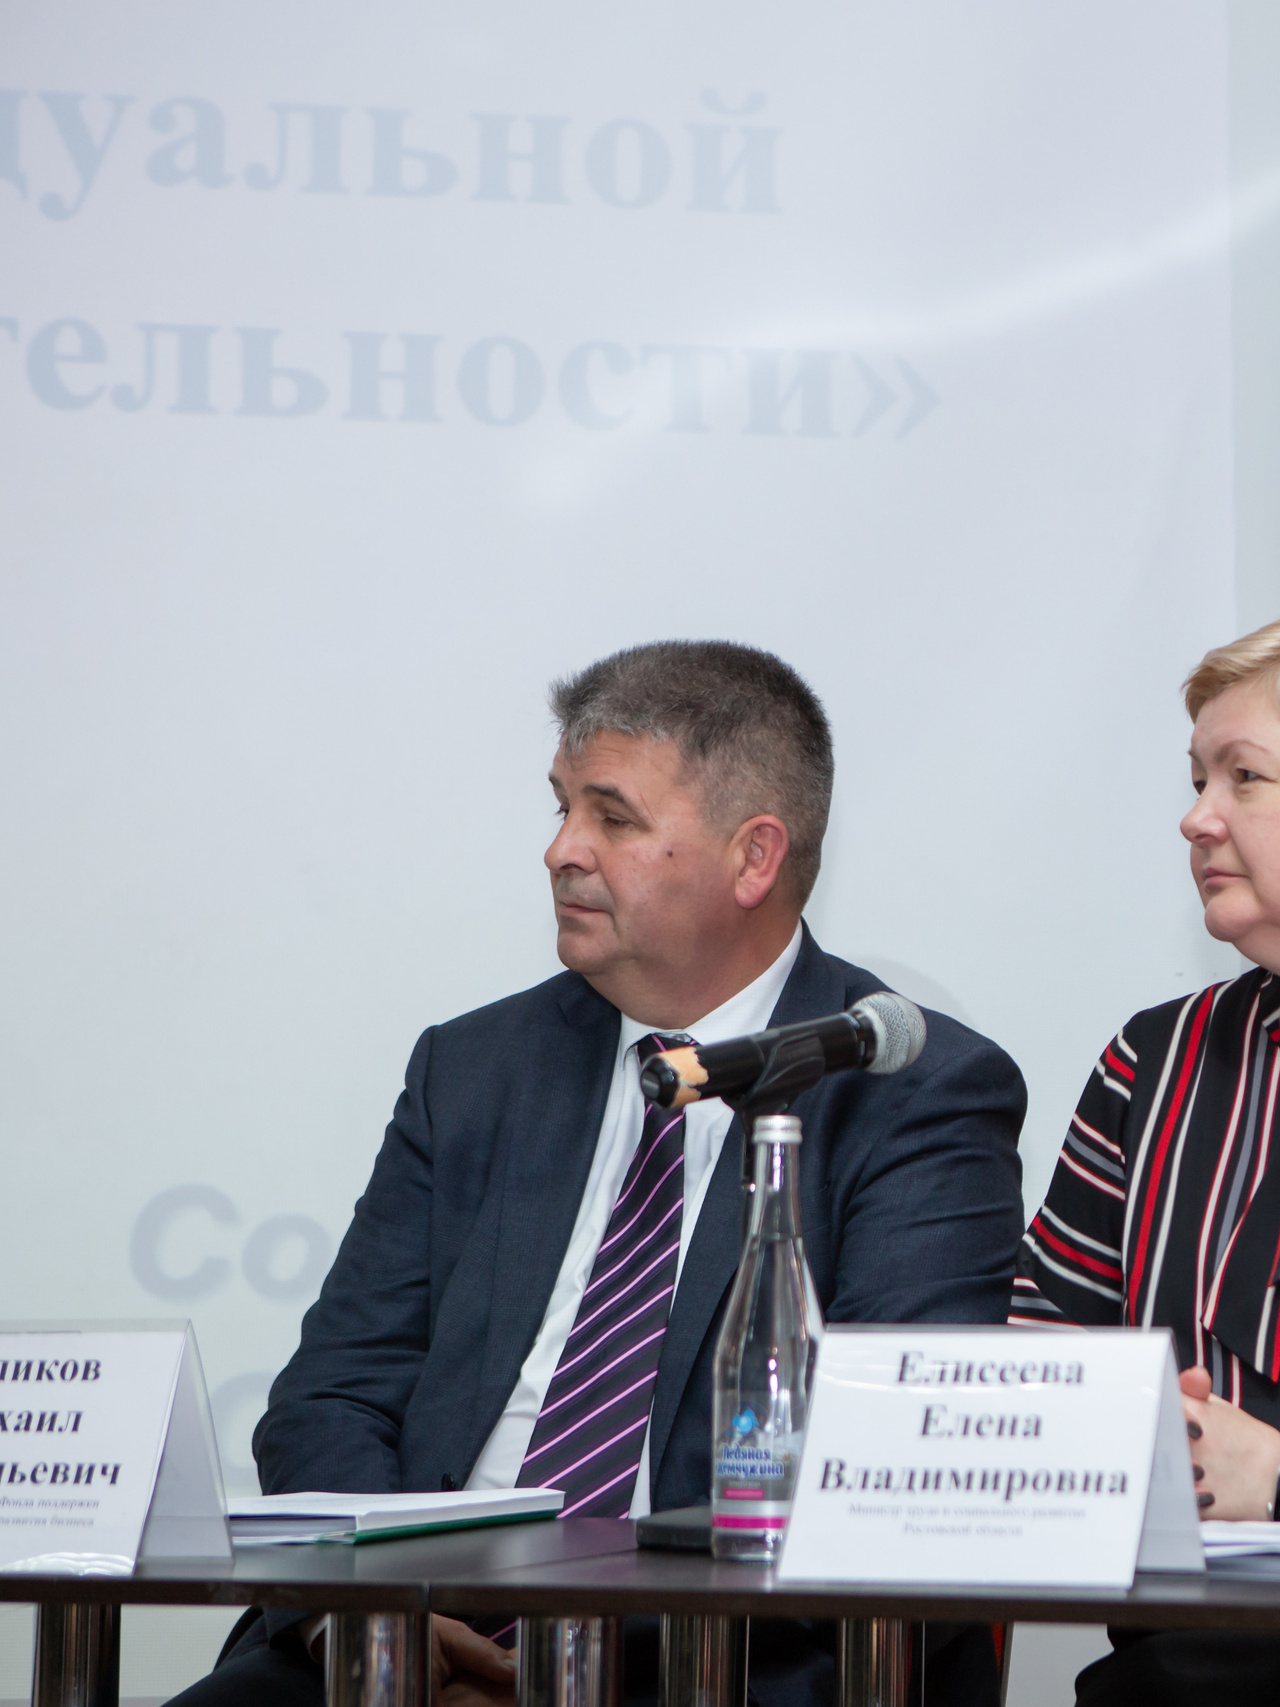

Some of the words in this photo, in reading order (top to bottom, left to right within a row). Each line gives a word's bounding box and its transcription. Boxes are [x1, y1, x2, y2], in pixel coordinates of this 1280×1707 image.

[129, 1183, 334, 1302] Со
[898, 1350, 1085, 1386] Елисеева
[919, 1404, 1043, 1439] Елена
[820, 1458, 1129, 1502] Владимировна
